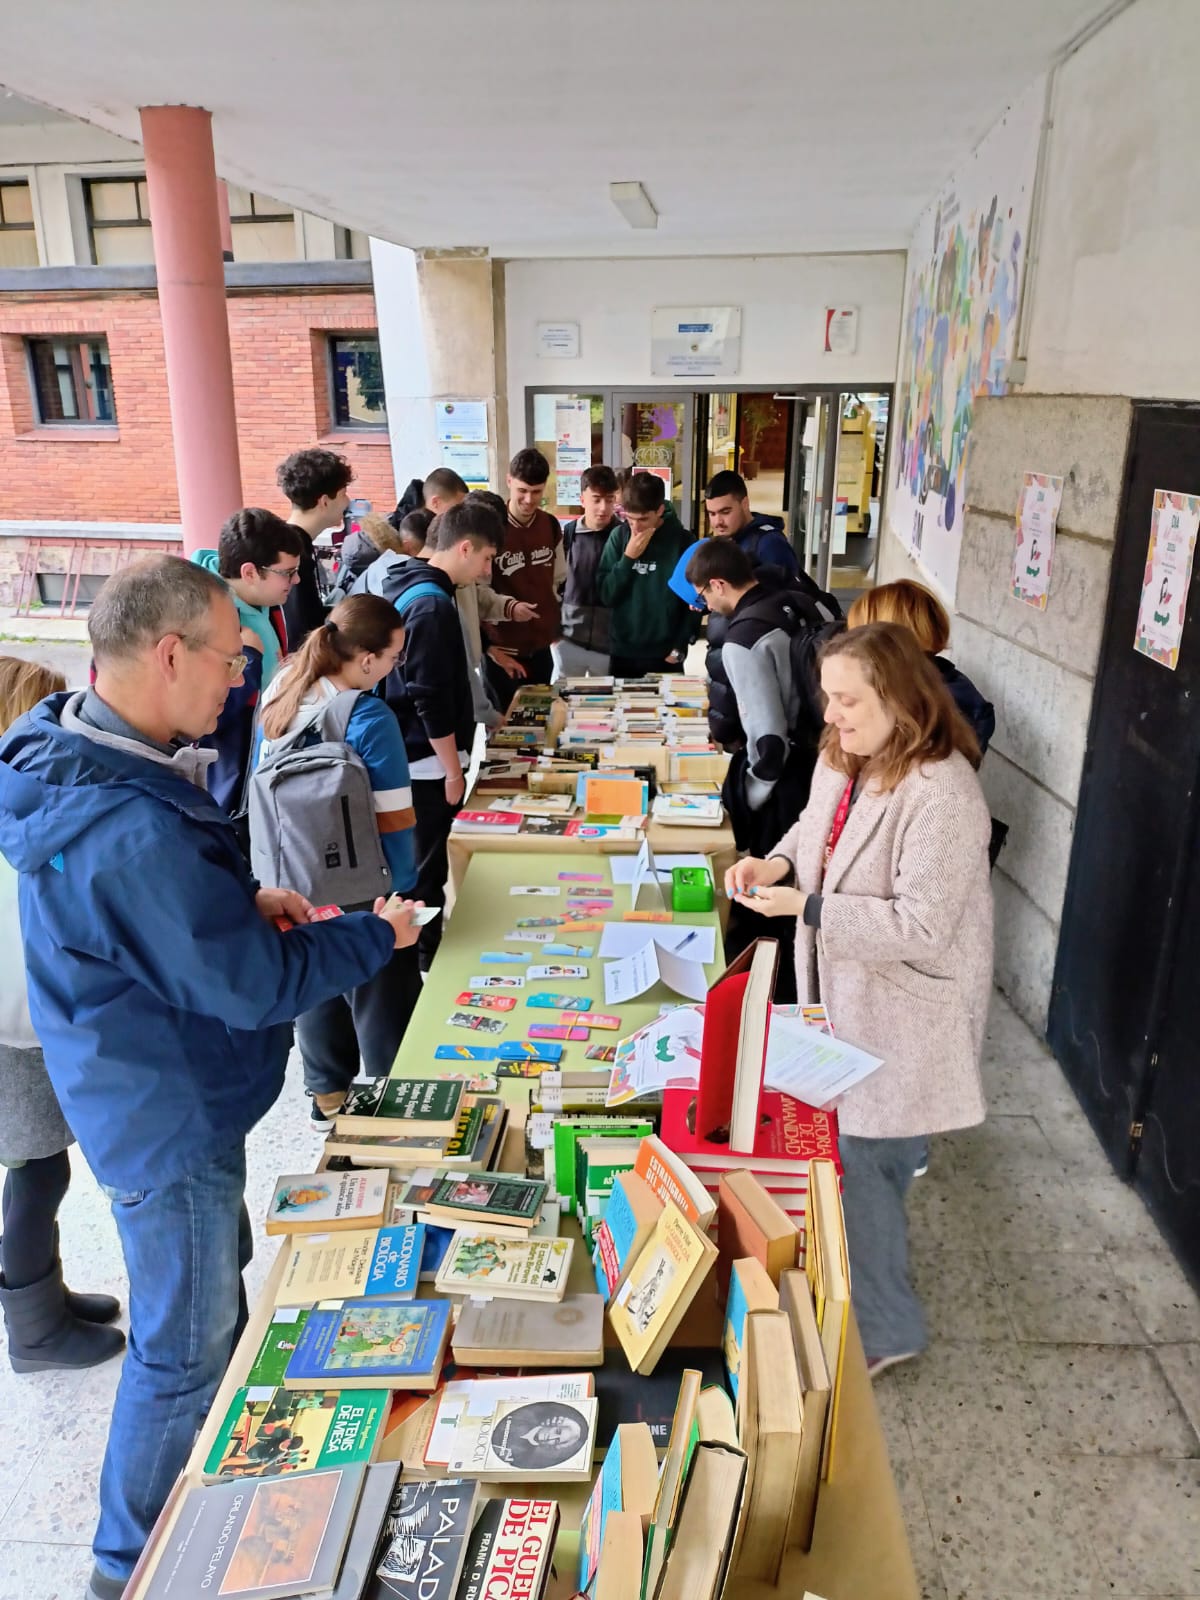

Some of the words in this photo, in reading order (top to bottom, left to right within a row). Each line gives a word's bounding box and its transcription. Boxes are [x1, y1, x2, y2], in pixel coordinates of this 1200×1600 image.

[780, 1094, 801, 1155] MANIDAD
[799, 1123, 815, 1138] DE
[812, 1112, 832, 1156] ISTORIA
[801, 1140, 816, 1156] LA
[388, 1251, 400, 1263] de
[394, 1226, 416, 1288] DICCIONARIO
[337, 1405, 353, 1420] DE
[349, 1407, 364, 1421] EL
[326, 1421, 347, 1454] MESA
[340, 1420, 360, 1451] TENIS
[650, 1424, 668, 1436] NE
[218, 1494, 244, 1545] ORLANDO
[502, 1499, 531, 1536] DE
[527, 1500, 552, 1530] EL
[475, 1532, 492, 1568] FRANK
[200, 1545, 225, 1589] PELAYO
[470, 1575, 481, 1583] D.
